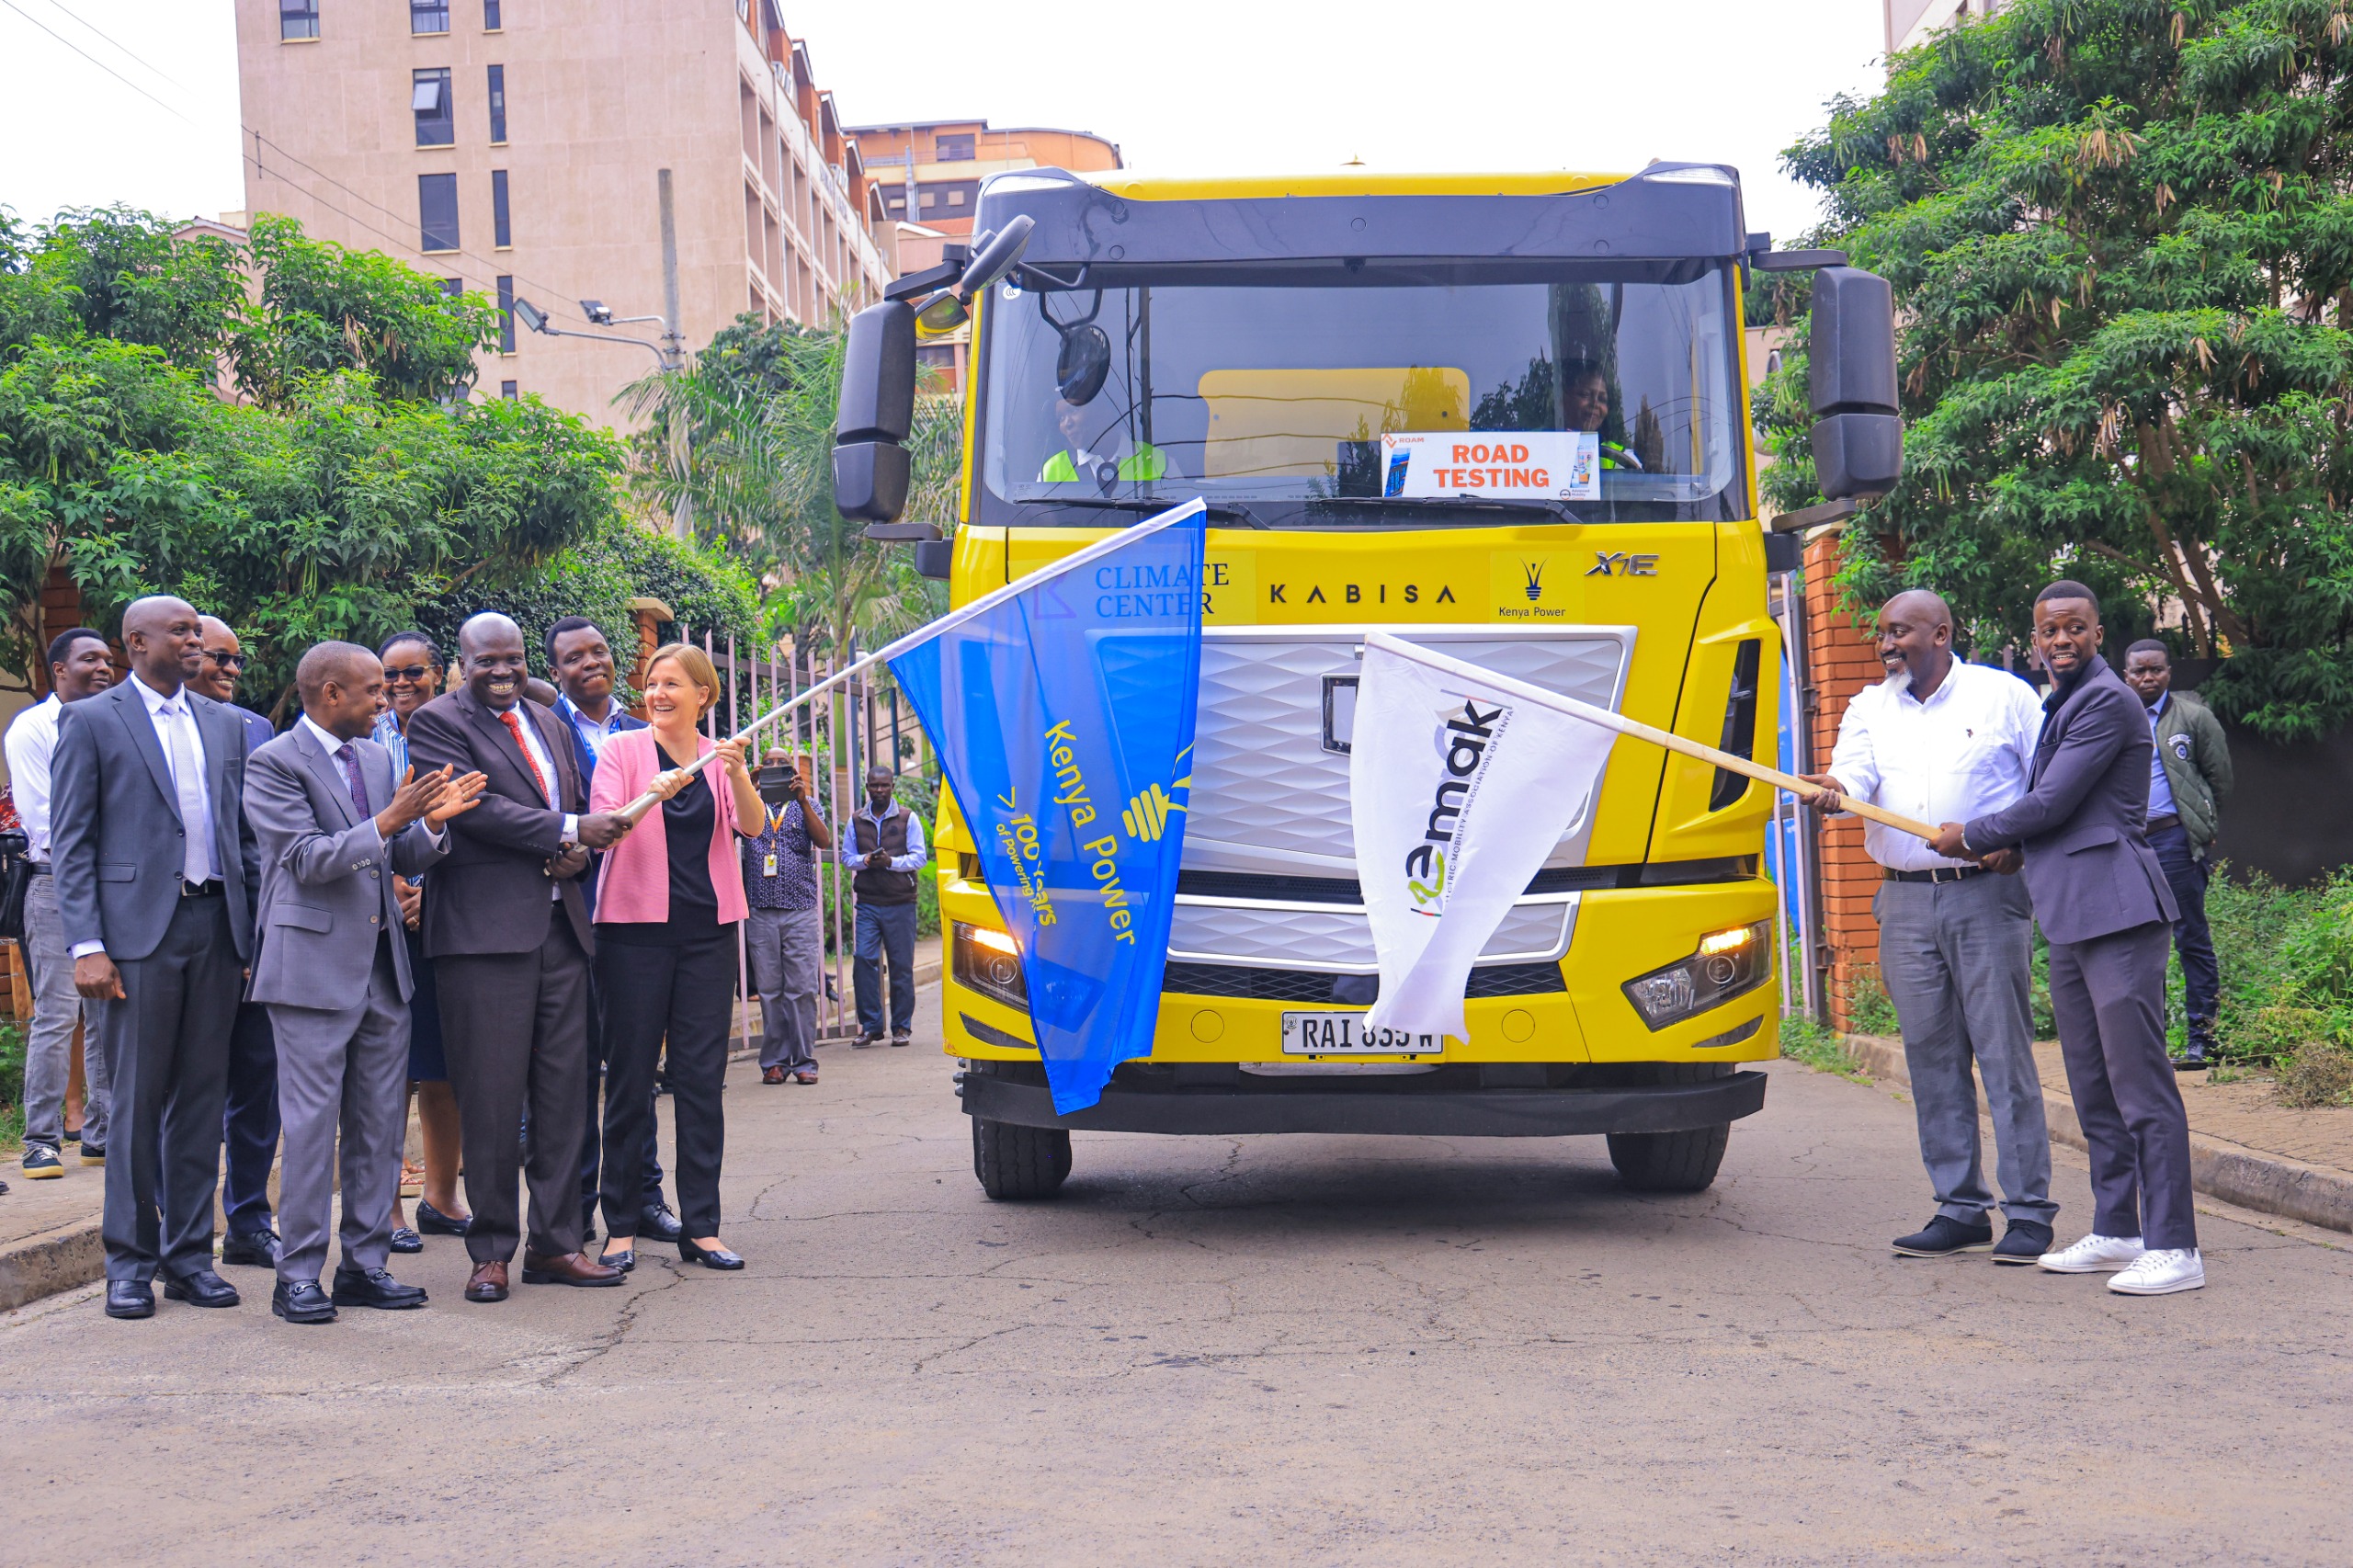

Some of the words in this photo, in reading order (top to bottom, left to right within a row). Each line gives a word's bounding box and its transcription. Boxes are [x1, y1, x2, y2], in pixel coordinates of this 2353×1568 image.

[1451, 444, 1529, 463] ROAD
[1433, 469, 1550, 488] TESTING
[1095, 562, 1230, 590] CLIMATE
[1095, 593, 1215, 619] CENTER
[1270, 584, 1456, 604] KABISA
[1499, 607, 1529, 619] Kenya
[1533, 607, 1566, 617] Power
[1495, 710, 1515, 738] KENYA
[1405, 699, 1504, 904] emak
[995, 823, 1012, 836] of
[1009, 813, 1040, 861] 100
[1044, 719, 1097, 828] Kenya
[1083, 835, 1135, 946] Power
[1002, 838, 1035, 896] Powering
[1302, 1019, 1352, 1048] RAI
